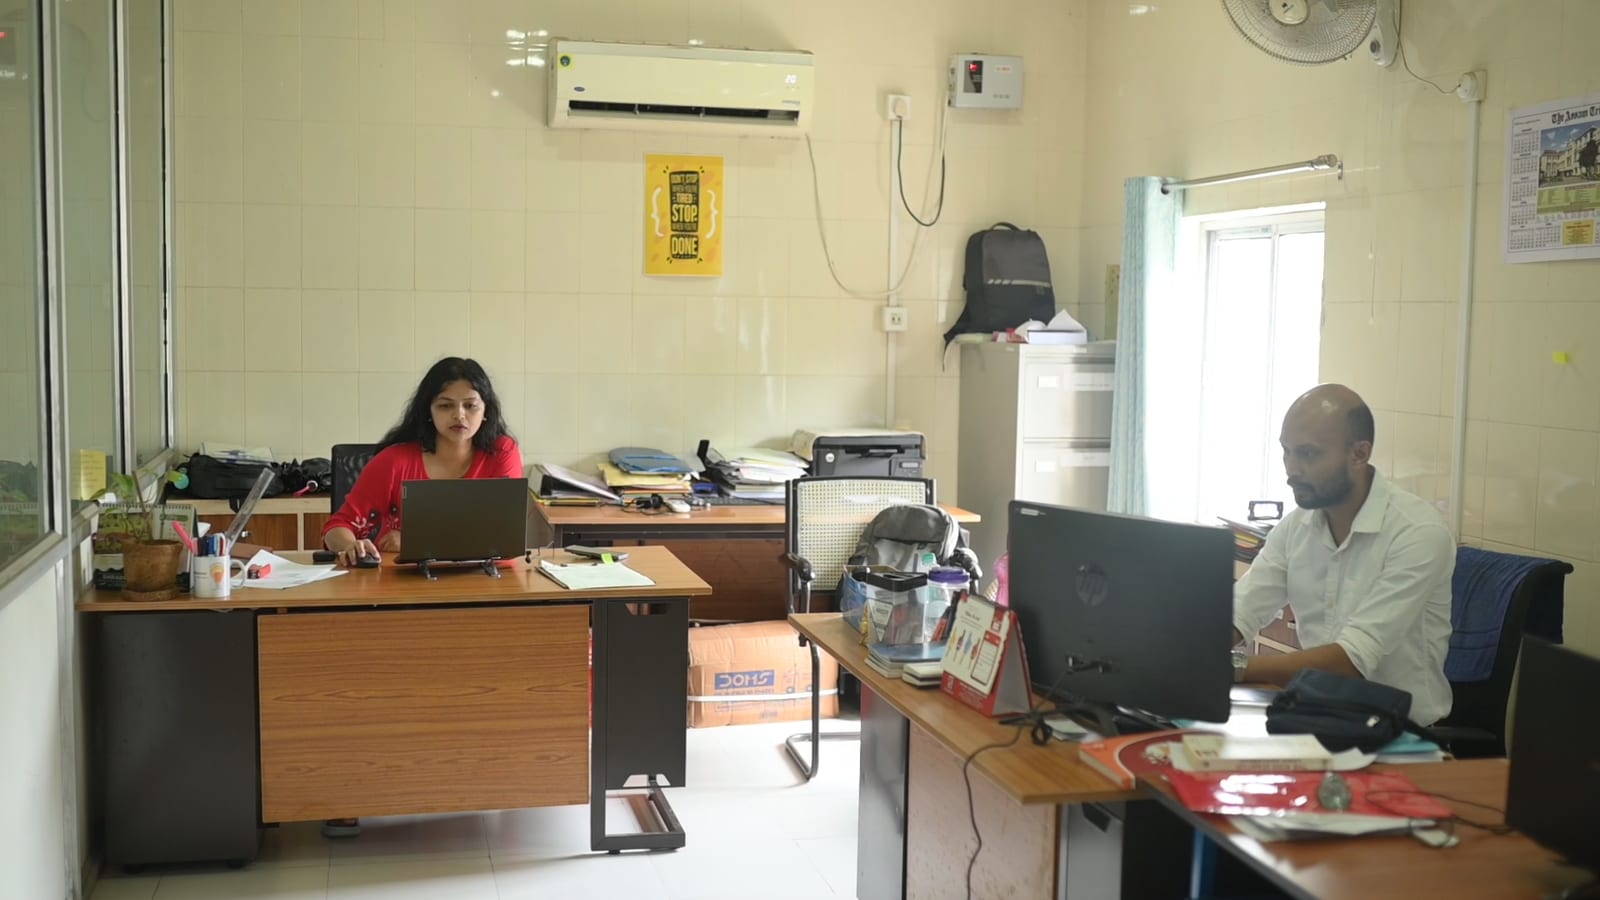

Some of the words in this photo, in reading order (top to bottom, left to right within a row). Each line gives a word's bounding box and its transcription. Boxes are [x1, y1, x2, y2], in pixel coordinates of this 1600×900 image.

[1551, 112, 1565, 125] The
[1564, 110, 1588, 122] Assam
[672, 204, 698, 222] STOP.
[672, 237, 698, 255] DONE
[719, 672, 771, 687] DOMS
